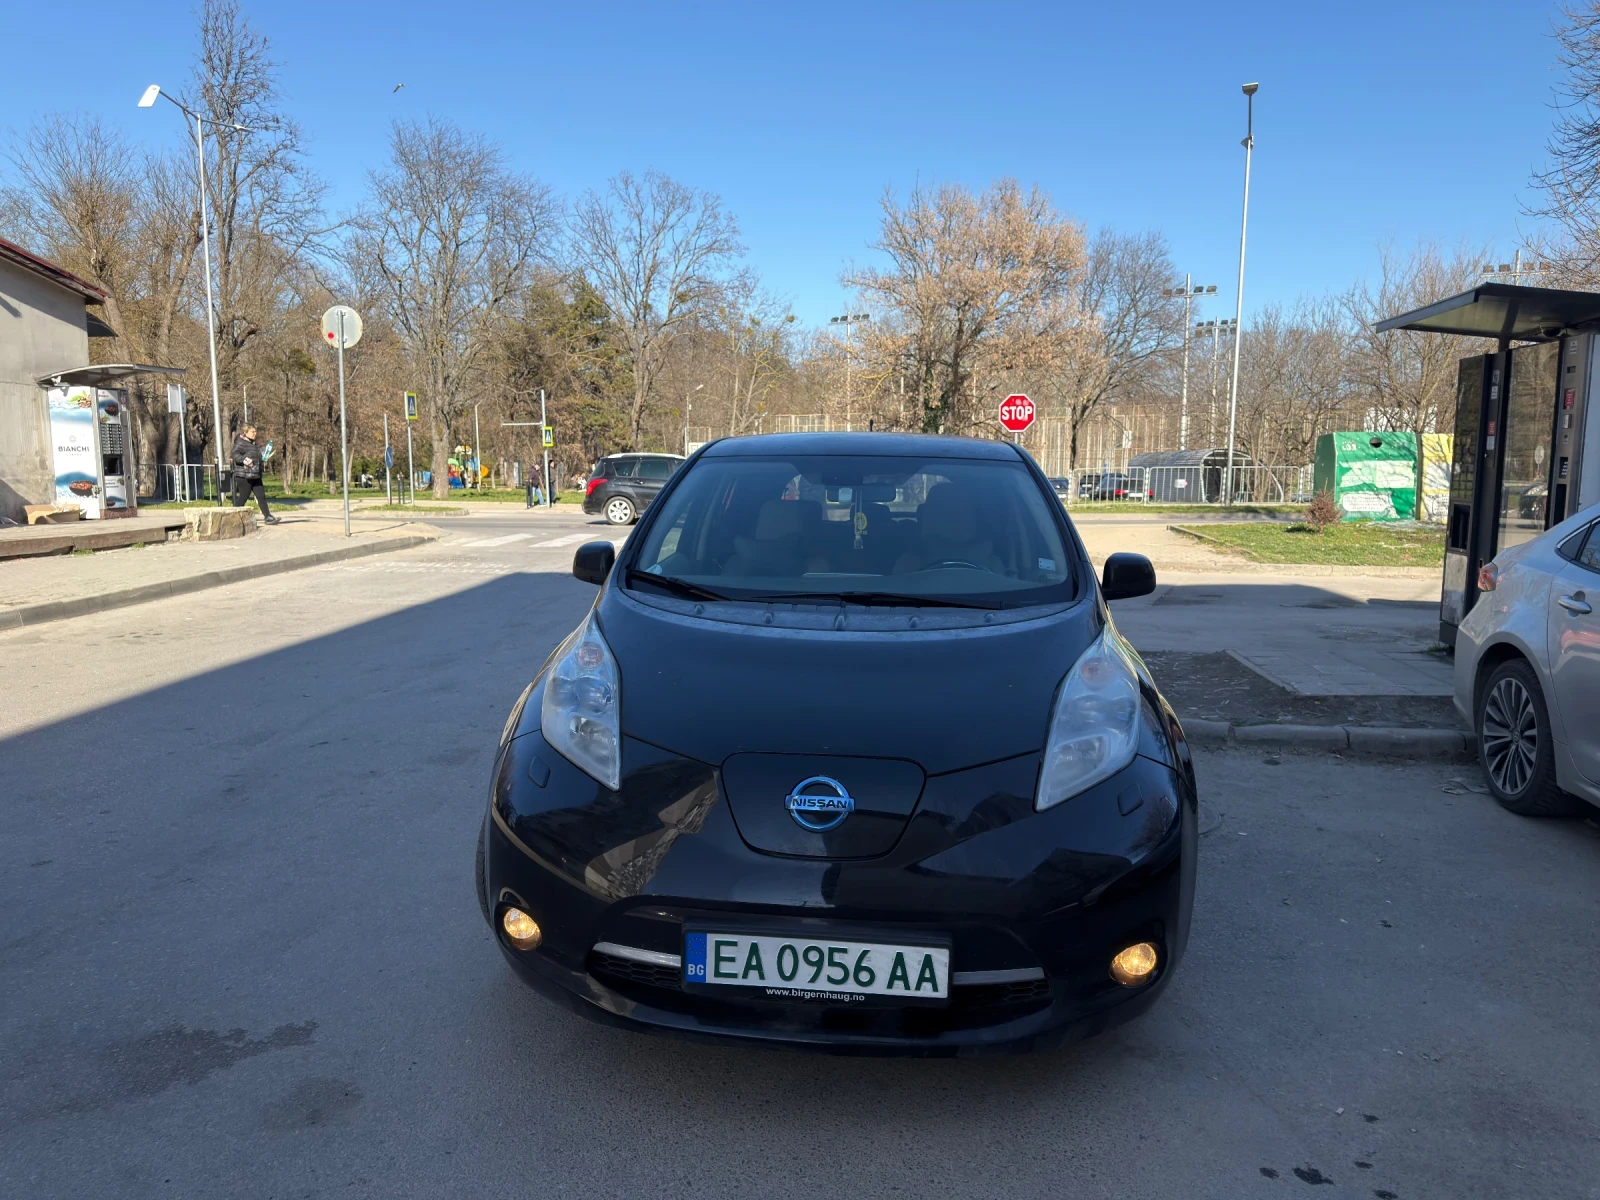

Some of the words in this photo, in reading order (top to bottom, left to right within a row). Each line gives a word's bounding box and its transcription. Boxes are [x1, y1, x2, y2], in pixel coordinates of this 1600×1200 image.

[1001, 405, 1033, 420] STOP
[792, 798, 847, 808] NISSAN
[687, 963, 705, 976] BG
[713, 939, 766, 980] EA
[776, 943, 876, 988] 0956
[886, 951, 939, 992] AA
[766, 987, 865, 1002] www.birgernhaug.no
